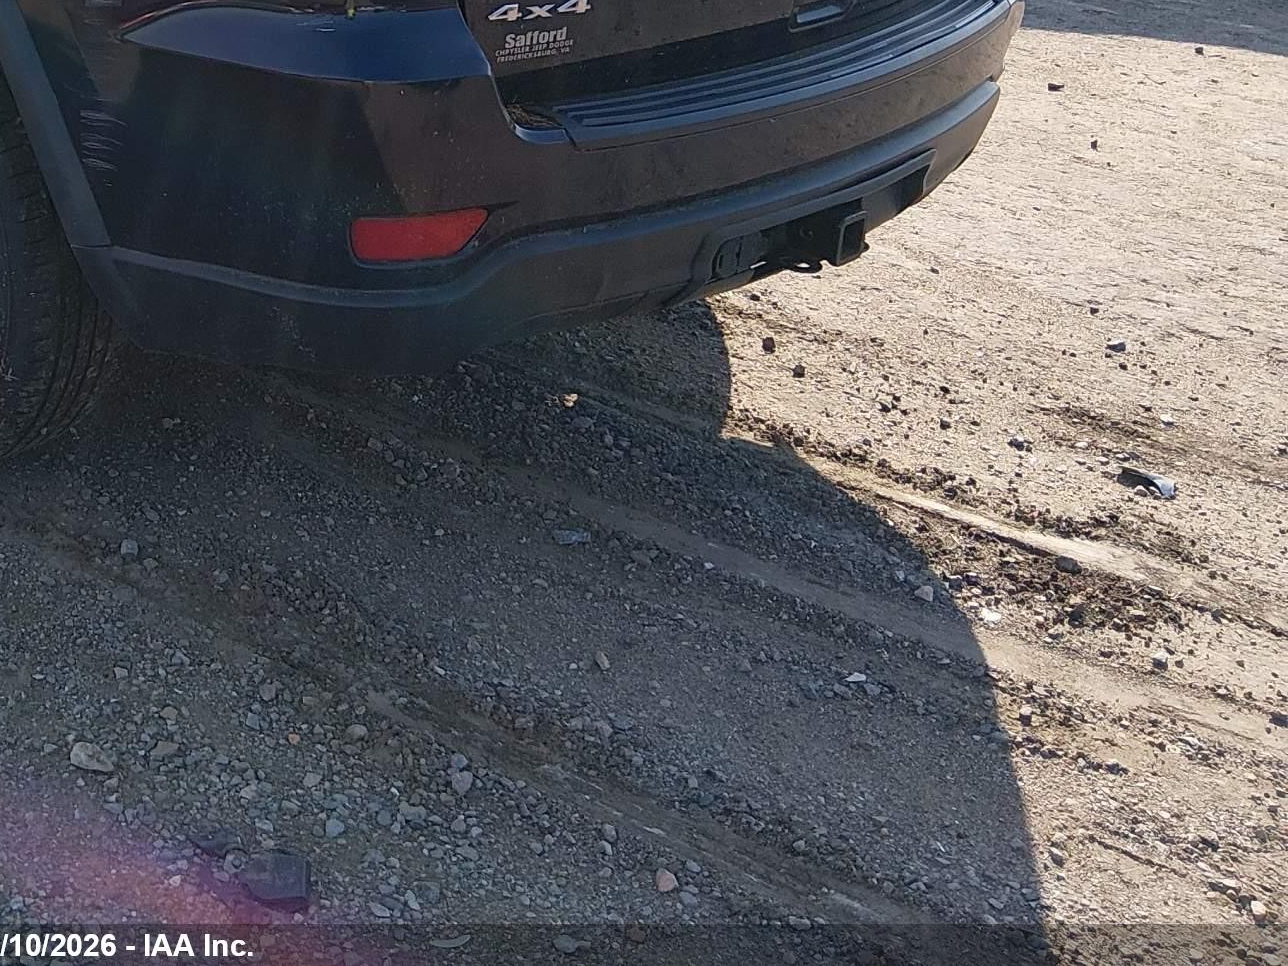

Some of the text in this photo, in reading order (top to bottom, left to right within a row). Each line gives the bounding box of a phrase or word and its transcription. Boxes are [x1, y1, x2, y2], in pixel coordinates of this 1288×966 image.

[504, 26, 568, 49] Safford
[531, 43, 548, 52] JEEP
[549, 39, 574, 49] DODGE
